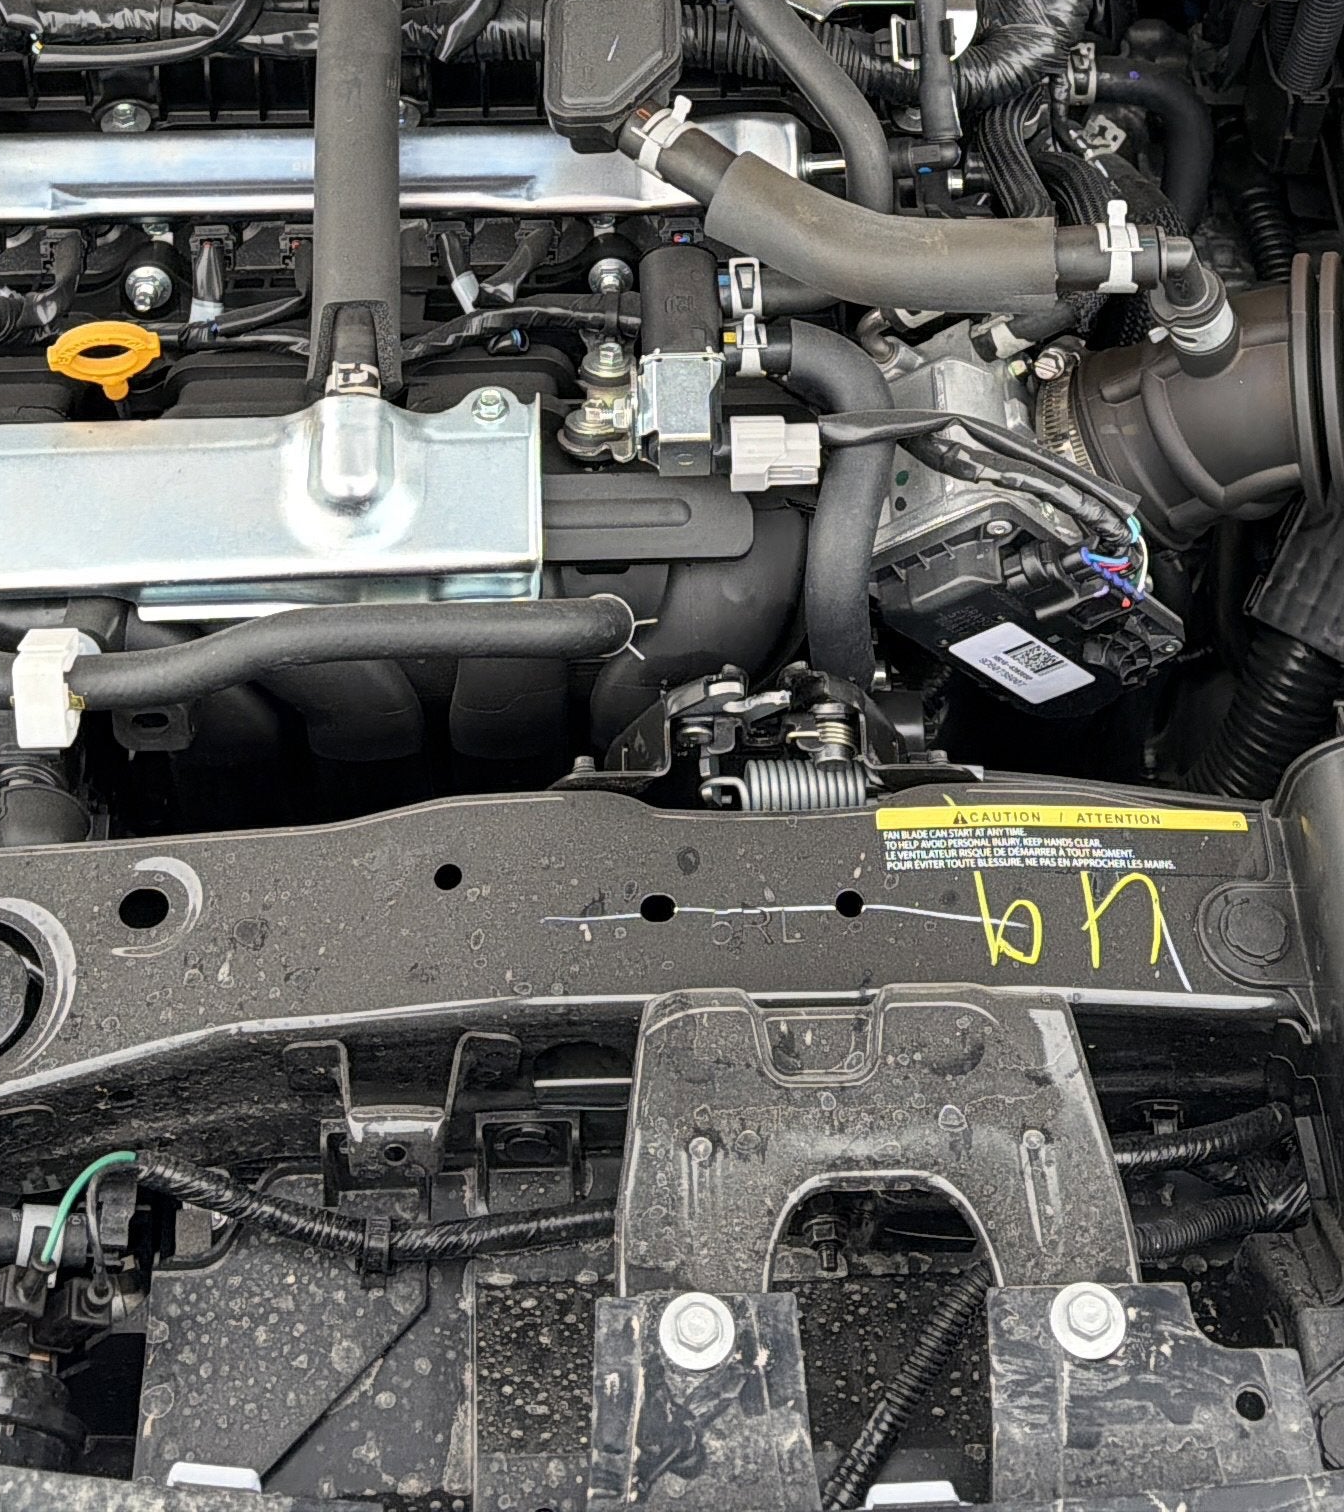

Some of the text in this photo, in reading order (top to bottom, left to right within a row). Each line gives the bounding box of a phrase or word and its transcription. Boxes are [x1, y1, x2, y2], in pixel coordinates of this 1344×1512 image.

[969, 811, 1041, 823] CAUTION
[1076, 812, 1161, 825] ATTENTION
[883, 831, 900, 840] FAN
[901, 830, 928, 839] BLADE
[929, 829, 948, 839] CAN
[949, 829, 973, 838] START
[975, 828, 985, 837] AT
[885, 841, 897, 850] TO
[898, 840, 919, 849] HELP
[921, 840, 947, 849] AVOID
[948, 838, 991, 848] PERSONAL
[1023, 838, 1043, 846] KEEP
[1044, 838, 1074, 846] HANDS
[886, 851, 897, 860] LE
[897, 849, 957, 859] VENTILATEUR
[959, 848, 992, 858] RISQUE
[994, 848, 1007, 857] DE
[1008, 846, 1057, 857] DÉMARRER
[1067, 848, 1091, 857] TOUT
[1092, 848, 1135, 858] MOMENT.
[886, 861, 914, 871] POUR
[914, 859, 945, 870] ÉVITER
[946, 858, 976, 868] TOUTE
[1025, 857, 1038, 867] NE
[1040, 857, 1056, 867] PAS
[1058, 858, 1071, 867] EN
[1072, 859, 1126, 868] APPROCHER
[1127, 860, 1143, 868] LES
[1144, 860, 1176, 869] MAINS.
